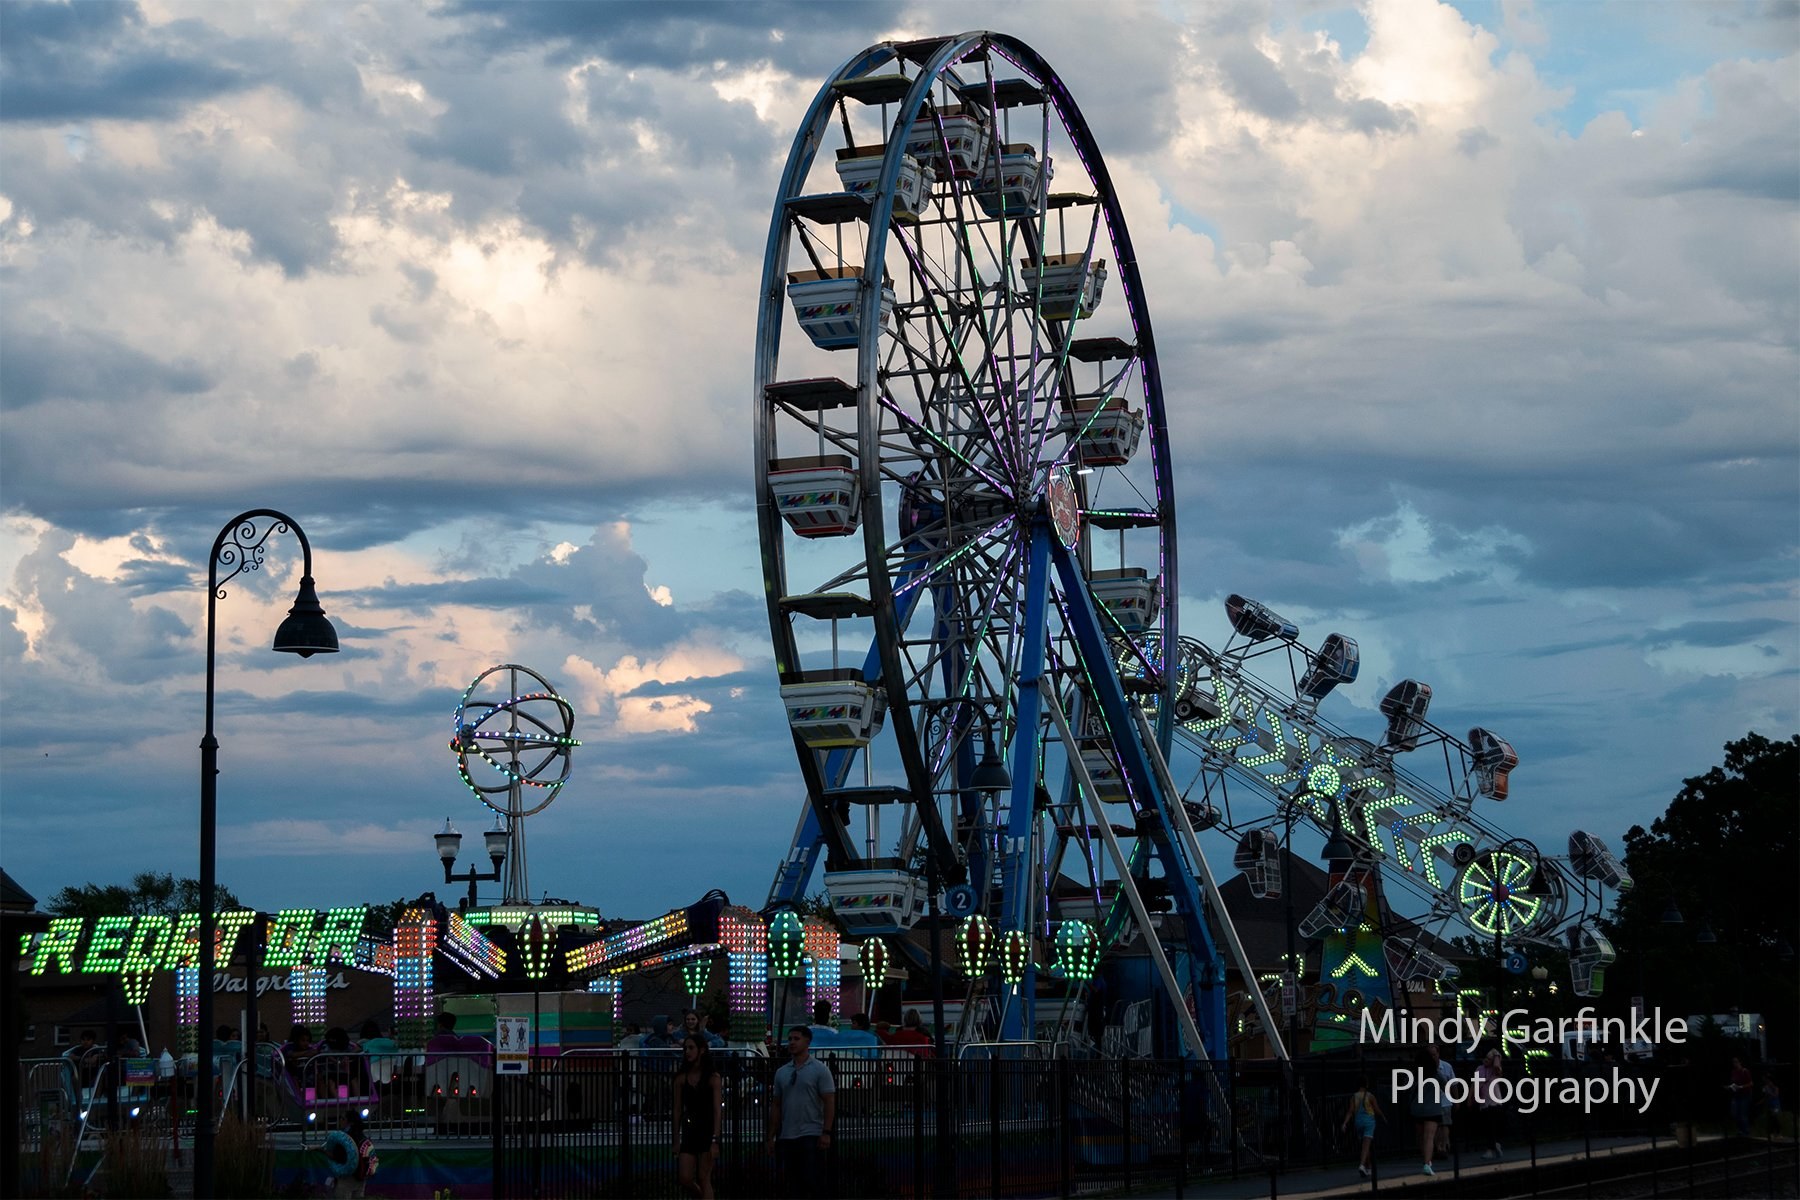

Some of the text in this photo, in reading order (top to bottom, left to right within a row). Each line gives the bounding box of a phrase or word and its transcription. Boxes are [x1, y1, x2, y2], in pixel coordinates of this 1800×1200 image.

[957, 892, 967, 909] 2
[20, 906, 368, 975] REDATOR
[1513, 958, 1520, 968] 2
